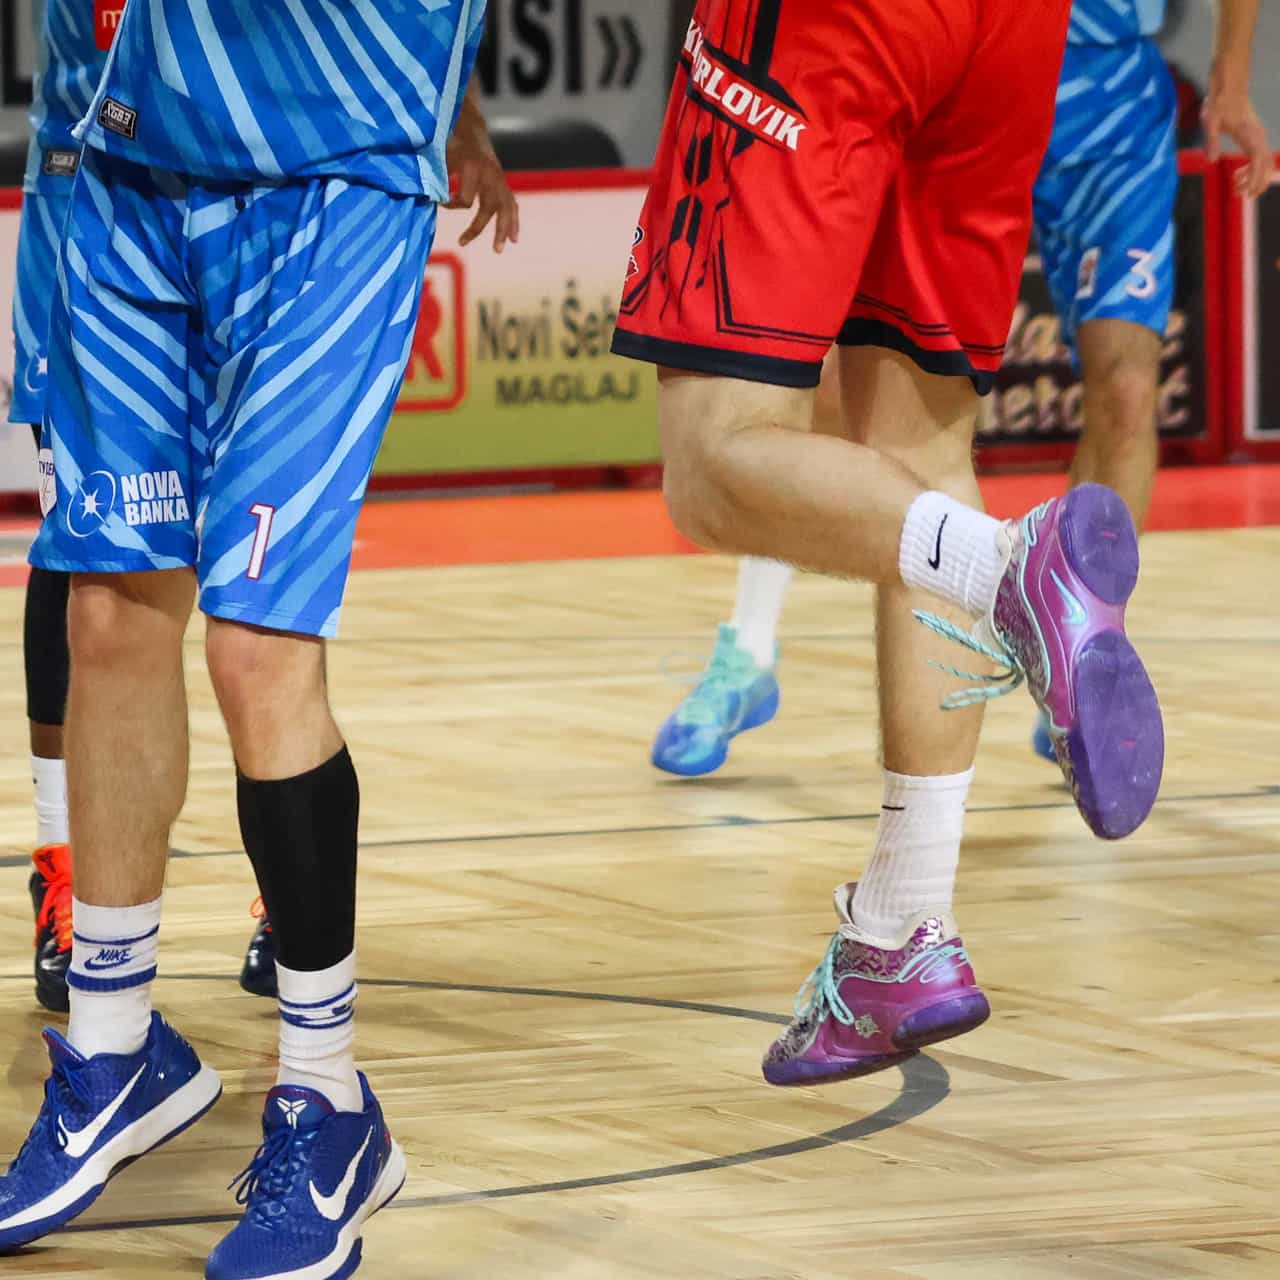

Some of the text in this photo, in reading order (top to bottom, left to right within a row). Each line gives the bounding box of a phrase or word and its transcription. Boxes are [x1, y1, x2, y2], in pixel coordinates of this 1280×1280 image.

[1123, 247, 1157, 298] 3
[477, 297, 552, 361] Novi
[496, 371, 639, 406] MAGLAJ
[121, 470, 184, 502] NOVA
[124, 499, 190, 526] BANKA
[246, 503, 276, 581] 1
[95, 948, 132, 962] NIKE
